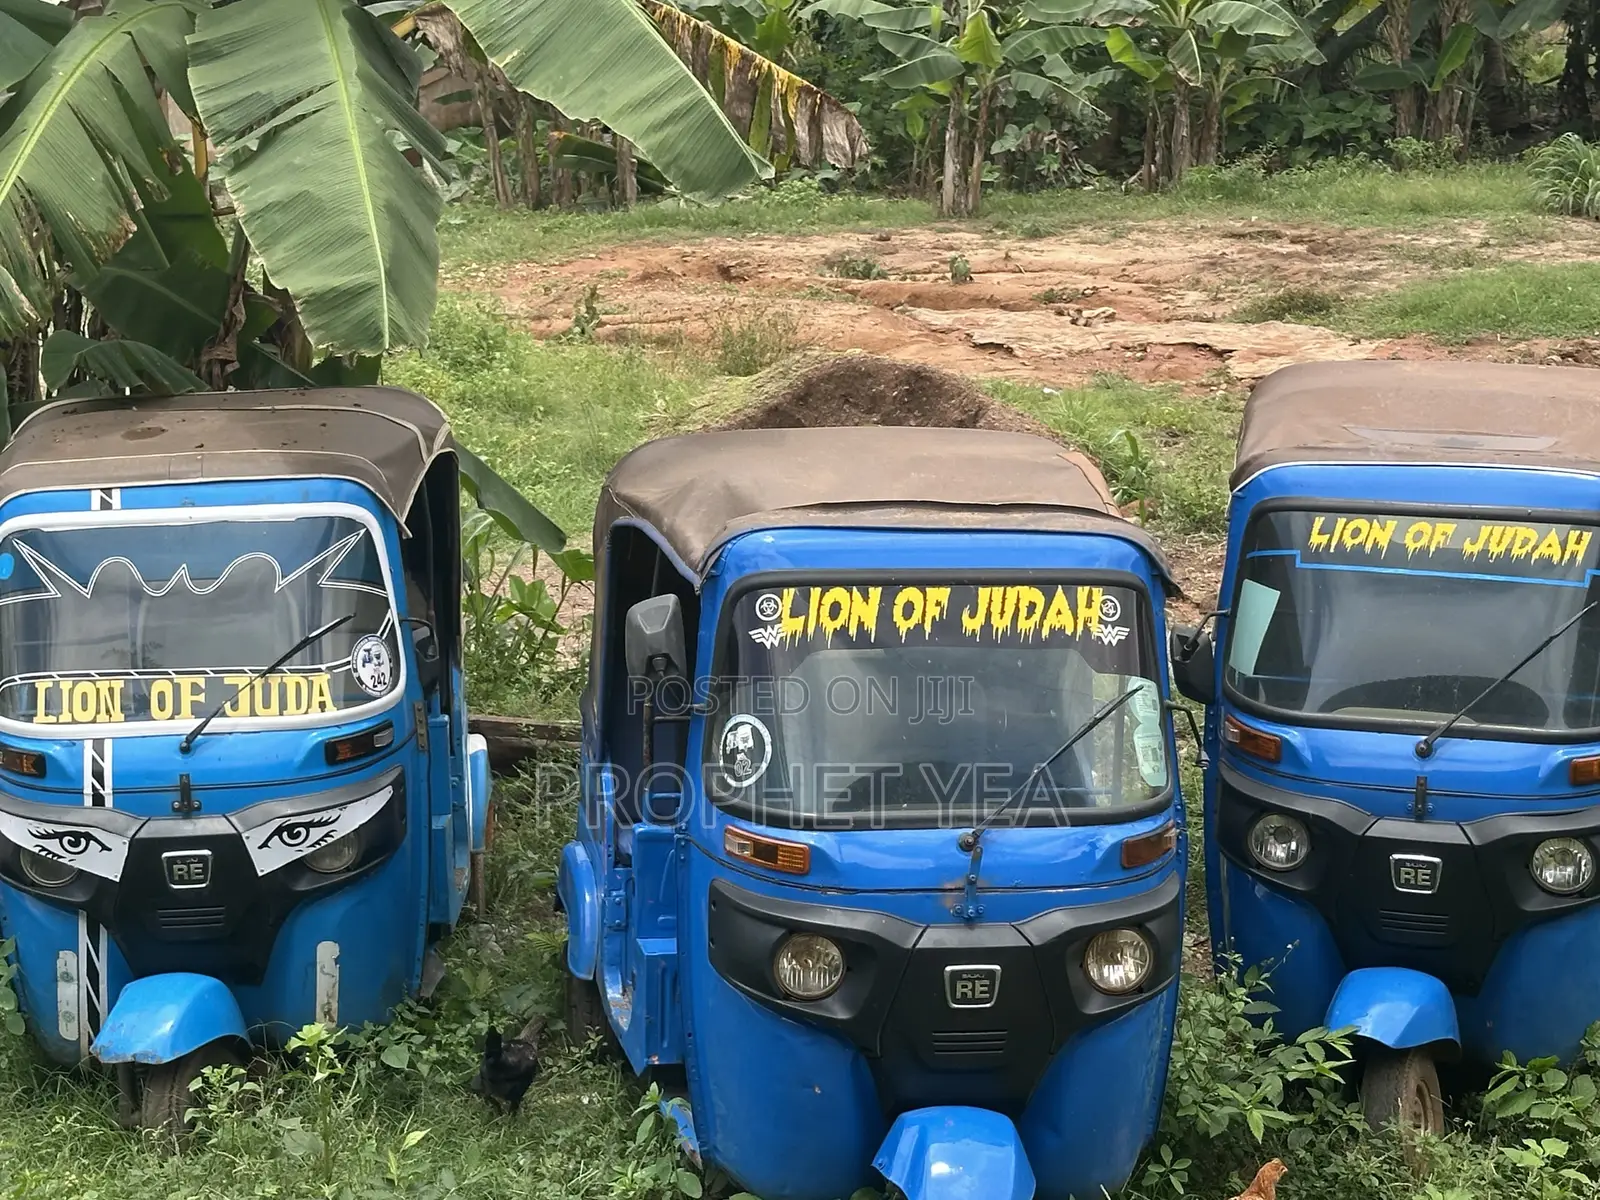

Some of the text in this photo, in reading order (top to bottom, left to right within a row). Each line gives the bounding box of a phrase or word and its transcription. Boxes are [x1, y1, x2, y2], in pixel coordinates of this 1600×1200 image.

[1308, 516, 1593, 568] LION OF JUDAH
[780, 585, 1104, 652] LION OF JUDAH
[370, 672, 387, 689] 242
[33, 673, 338, 724] LION OF JUDA
[172, 863, 205, 881] RE
[1400, 867, 1432, 886] RE
[956, 980, 990, 999] RE
